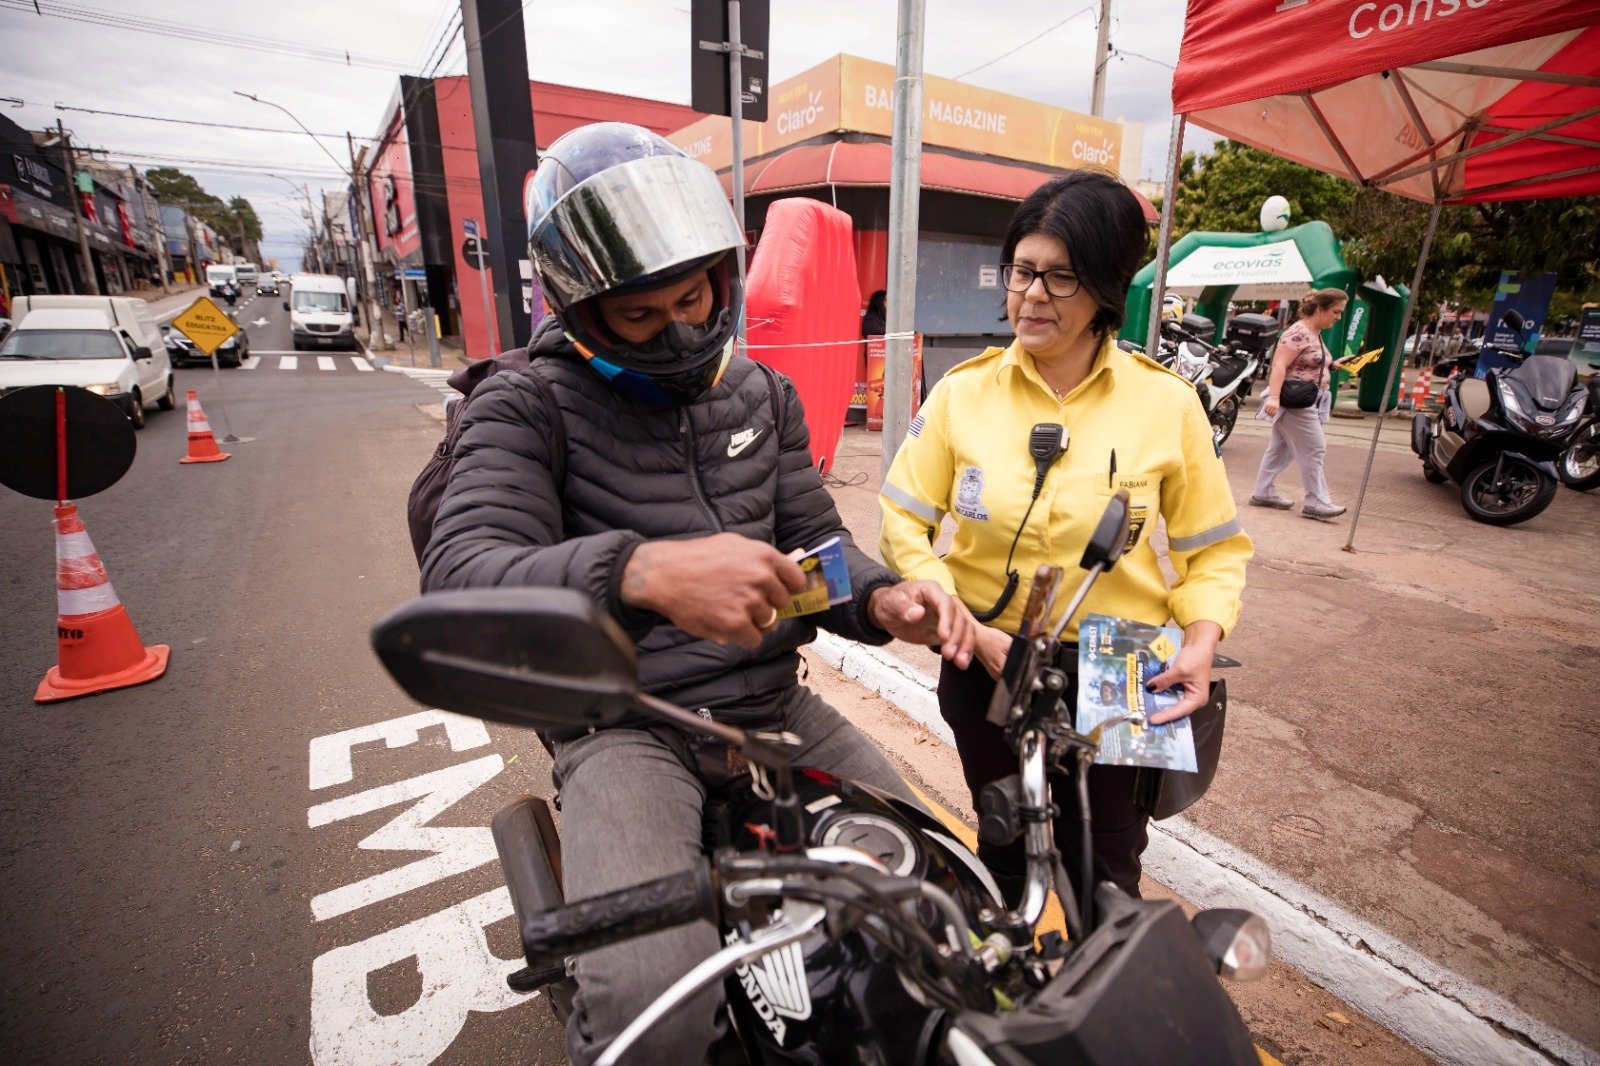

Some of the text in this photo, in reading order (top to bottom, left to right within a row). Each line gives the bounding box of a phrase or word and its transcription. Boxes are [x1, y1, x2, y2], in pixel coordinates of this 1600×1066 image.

[1348, 0, 1500, 39] Cons
[777, 104, 816, 135] Claro
[929, 100, 1006, 134] MAGAZINE
[1072, 140, 1107, 165] Claro
[1213, 258, 1283, 271] ecovias
[1236, 269, 1279, 278] Paulista
[195, 314, 216, 322] BLITZ
[185, 321, 228, 332] EDUCATIVA
[731, 428, 754, 447] NIKE
[961, 509, 989, 521] CARLOS
